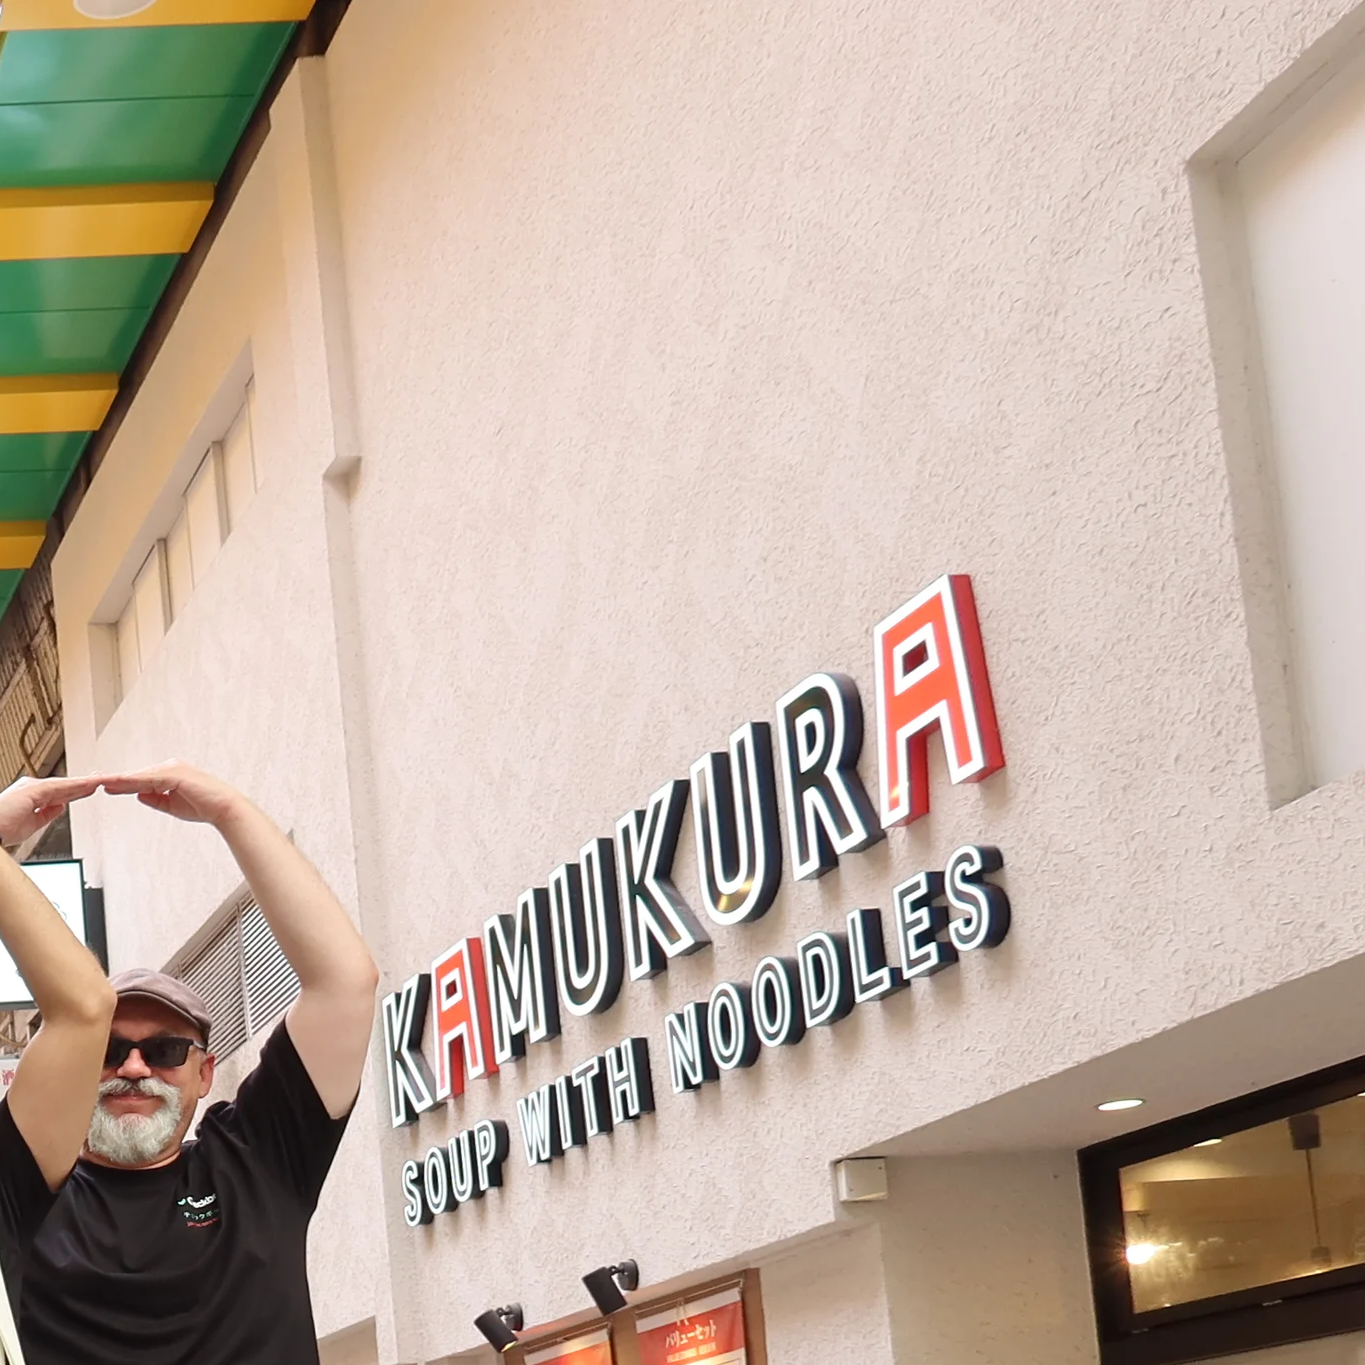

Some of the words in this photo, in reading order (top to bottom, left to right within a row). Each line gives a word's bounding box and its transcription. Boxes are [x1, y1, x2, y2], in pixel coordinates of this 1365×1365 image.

[381, 573, 1006, 1129] KAMUKURA
[401, 1119, 509, 1227] SOUP
[516, 1036, 656, 1167] WITH
[664, 844, 1012, 1095] NOODLES
[665, 1319, 717, 1349] バリューセット
